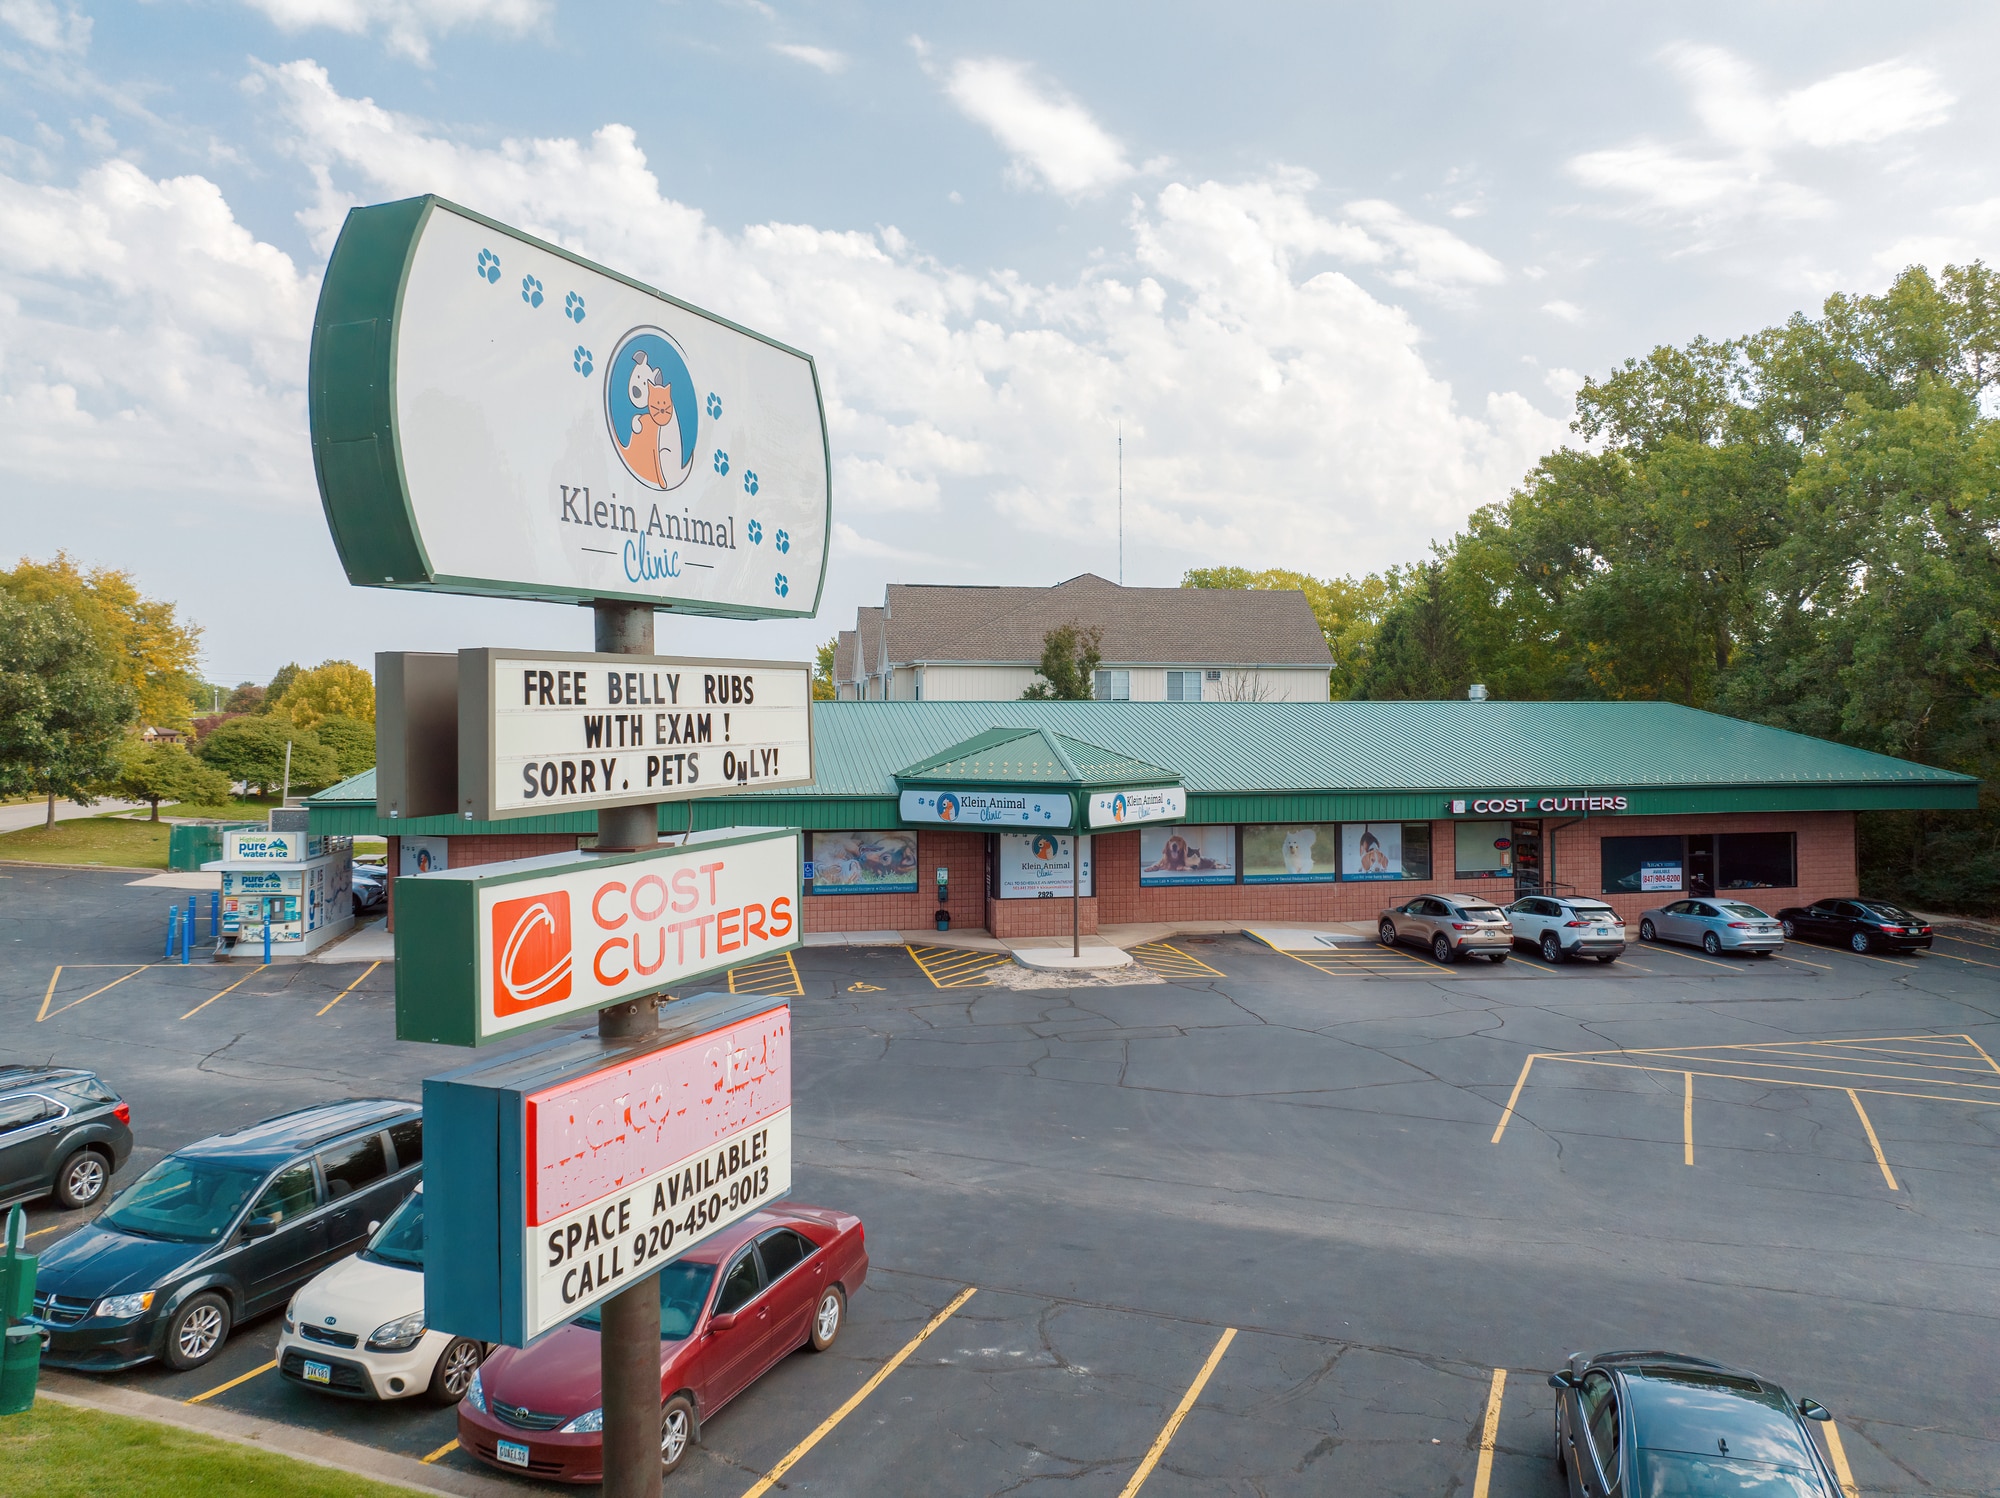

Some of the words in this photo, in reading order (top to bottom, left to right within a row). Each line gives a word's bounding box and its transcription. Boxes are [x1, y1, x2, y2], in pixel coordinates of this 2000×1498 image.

[560, 484, 638, 533] Klein
[646, 504, 736, 550] Animal
[624, 530, 681, 583] Clinic
[524, 670, 587, 705] FREE
[608, 672, 681, 705] BELLY
[704, 674, 754, 705] RUBS
[584, 714, 643, 749] WITH
[656, 713, 712, 745] EXAM
[647, 752, 699, 787] PETS
[961, 796, 986, 808] Klein
[990, 798, 1026, 809] Animal
[980, 806, 1002, 822] Clinic
[1126, 795, 1142, 806] Klein
[1143, 793, 1164, 805] Animal
[1472, 799, 1530, 814] COST
[1538, 796, 1628, 812] CUTTERS
[239, 843, 266, 854] pure
[1022, 862, 1041, 870] Klein
[242, 876, 263, 886] pure
[1036, 868, 1053, 878] Clinic
[592, 861, 724, 930] COST
[593, 896, 793, 987] CUTTERS
[549, 1198, 631, 1268] SPACE
[652, 1129, 768, 1217] AVAILABLE!
[562, 1245, 624, 1304] CALL
[634, 1166, 769, 1267] 920-450-9013
